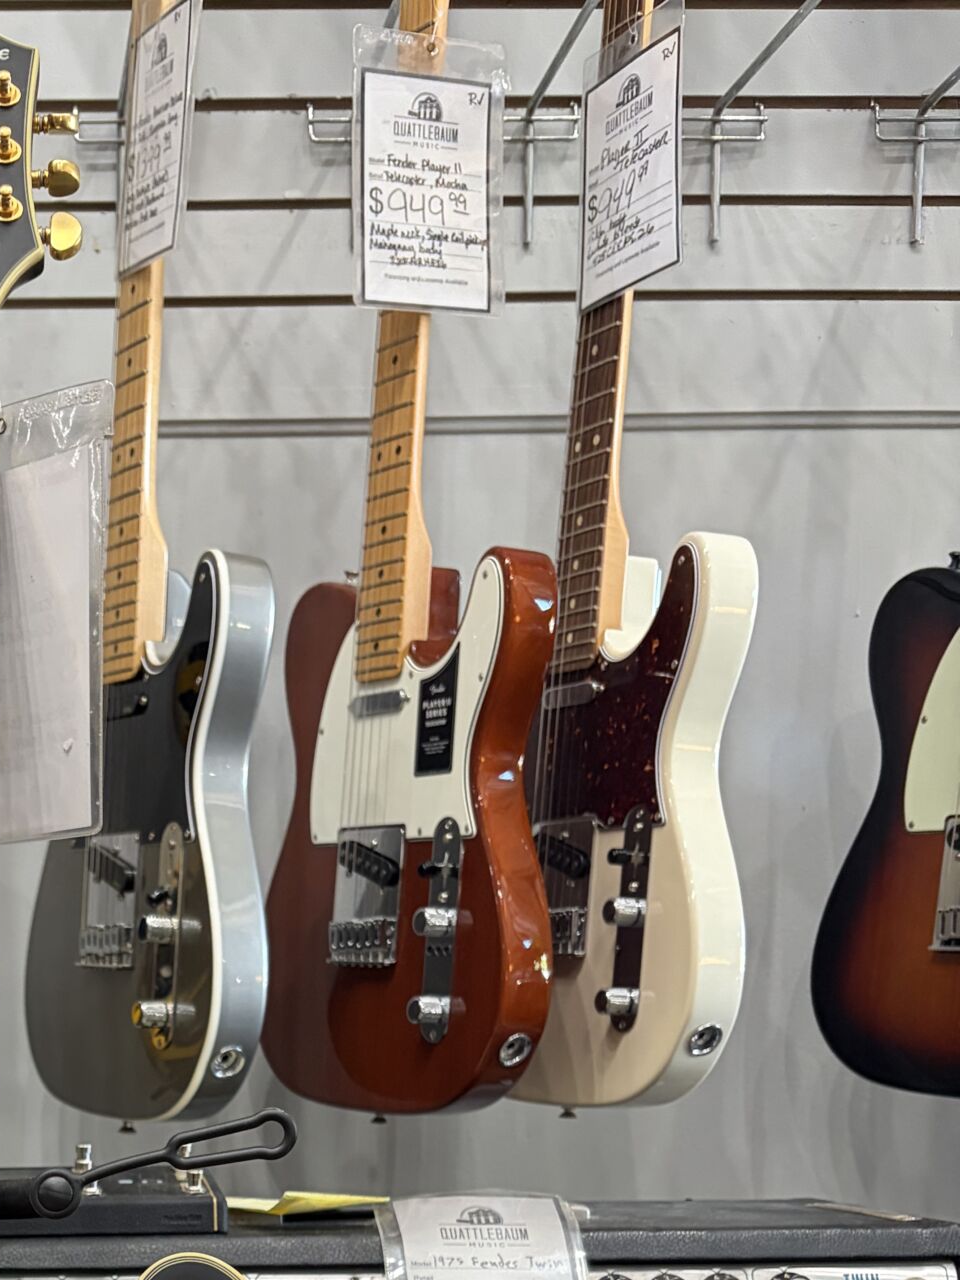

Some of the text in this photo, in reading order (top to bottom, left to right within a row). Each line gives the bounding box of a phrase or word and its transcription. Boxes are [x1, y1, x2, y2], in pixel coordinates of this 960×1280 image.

[606, 91, 653, 136] QUATTLEBAUM
[393, 120, 458, 143] QUATTLEBAUM
[412, 140, 440, 150] MUSIC
[387, 153, 417, 169] Fender
[369, 186, 467, 226] $949 99
[587, 169, 636, 222] $949
[440, 1226, 529, 1241] QUATTLEBAUM
